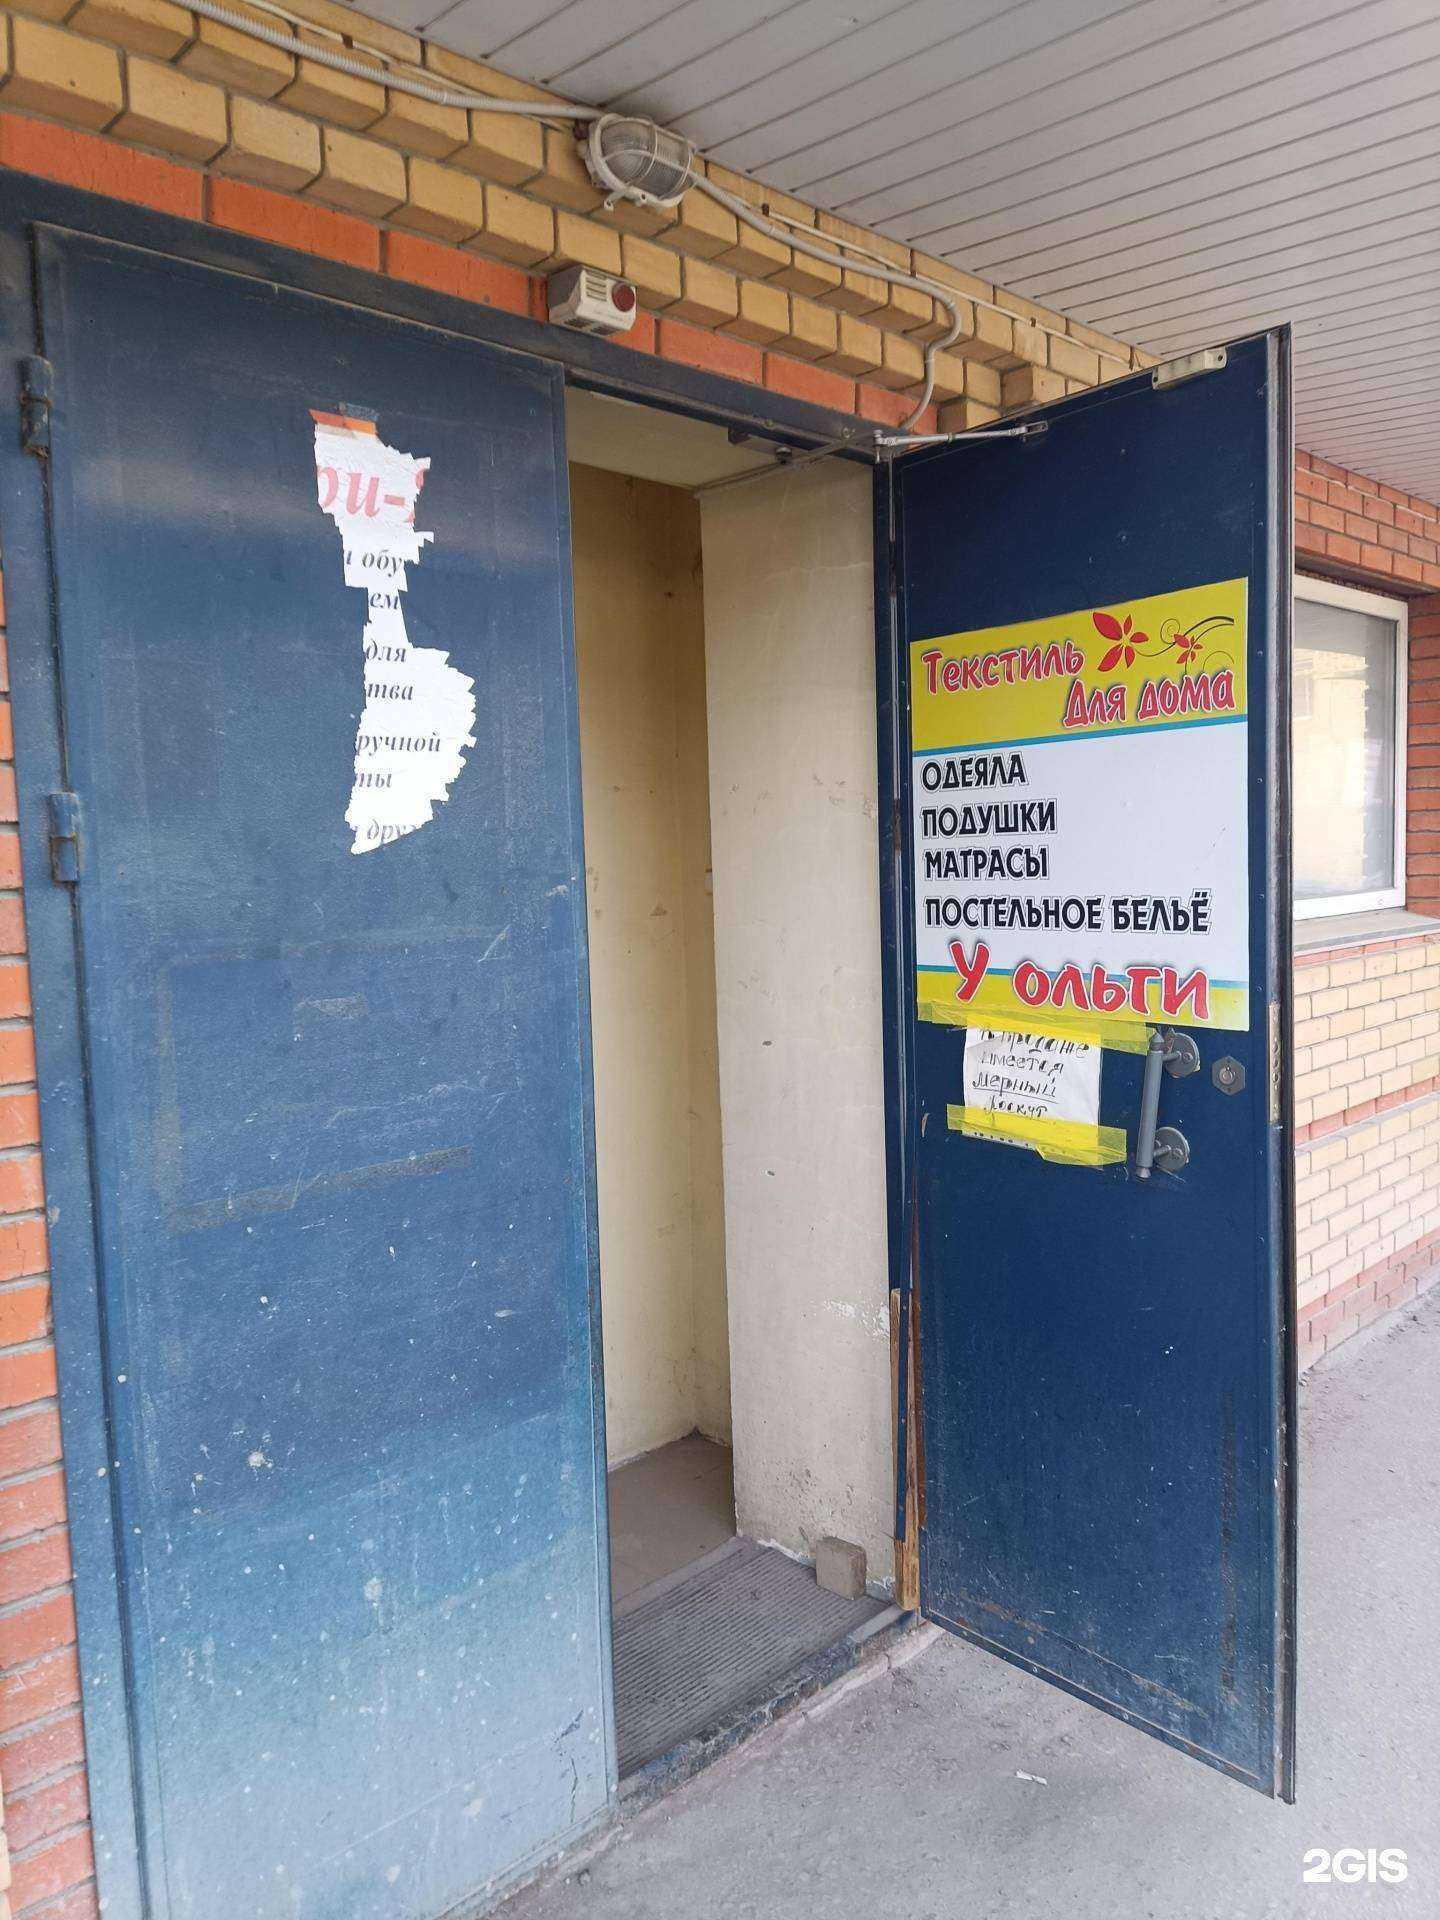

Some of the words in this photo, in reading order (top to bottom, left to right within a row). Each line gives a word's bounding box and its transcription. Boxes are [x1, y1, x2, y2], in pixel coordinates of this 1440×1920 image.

[366, 639, 406, 663] для
[921, 640, 1086, 695] Текстиль
[1063, 679, 1128, 728] Для
[1137, 669, 1237, 720] дома
[356, 731, 441, 756] ручной
[921, 752, 1028, 792] ОДЕЯЛА
[921, 800, 1057, 837] ПОДУШКИ
[923, 847, 1049, 879] МАТРАСЫ
[924, 896, 1103, 930] ПОСТЕЛЬНОЕ
[1111, 891, 1210, 932] БЕЛЬЁ
[950, 940, 991, 1003] У
